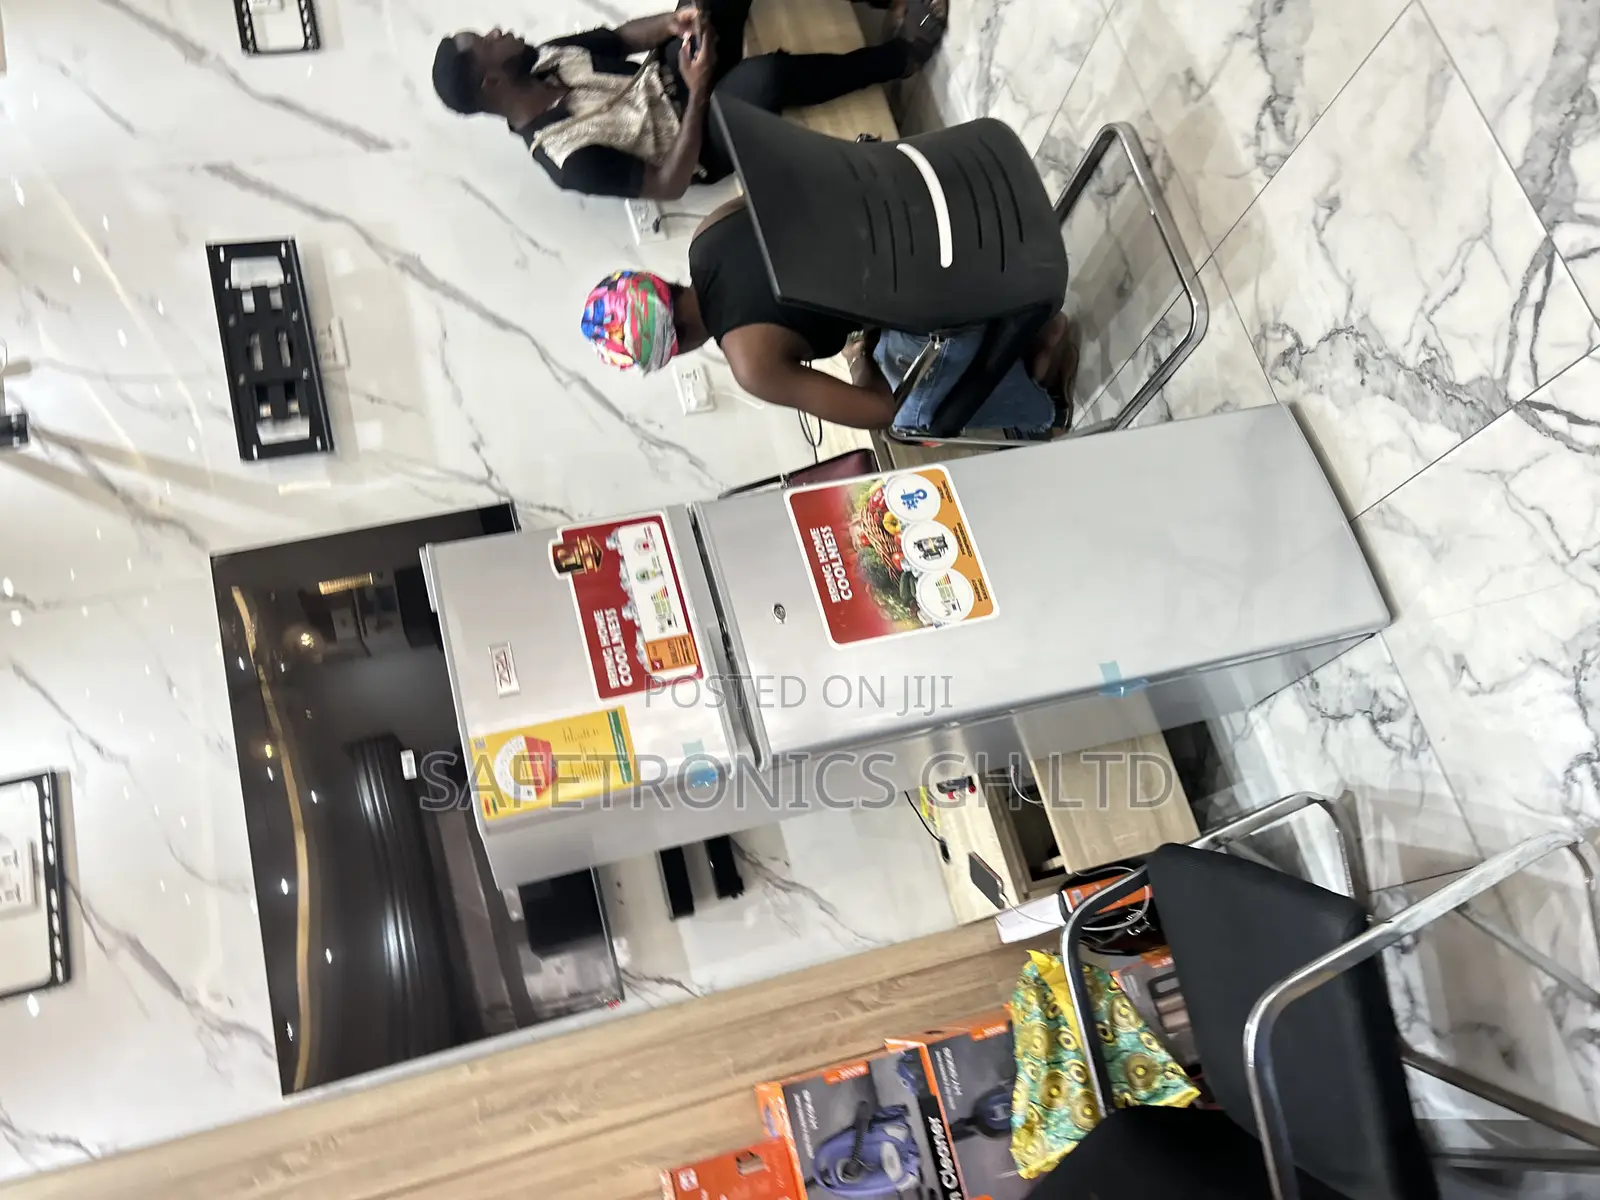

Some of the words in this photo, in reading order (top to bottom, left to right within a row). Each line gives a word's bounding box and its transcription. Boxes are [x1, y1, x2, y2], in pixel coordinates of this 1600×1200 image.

[809, 527, 830, 563] HOME
[820, 525, 853, 602] COOLNESS
[821, 564, 841, 603] BRING
[971, 579, 983, 602] ENERGY
[594, 609, 611, 647] HOME
[604, 608, 633, 687] COOLNESS
[602, 648, 620, 689] BRING
[927, 1116, 960, 1191] Cleaner
